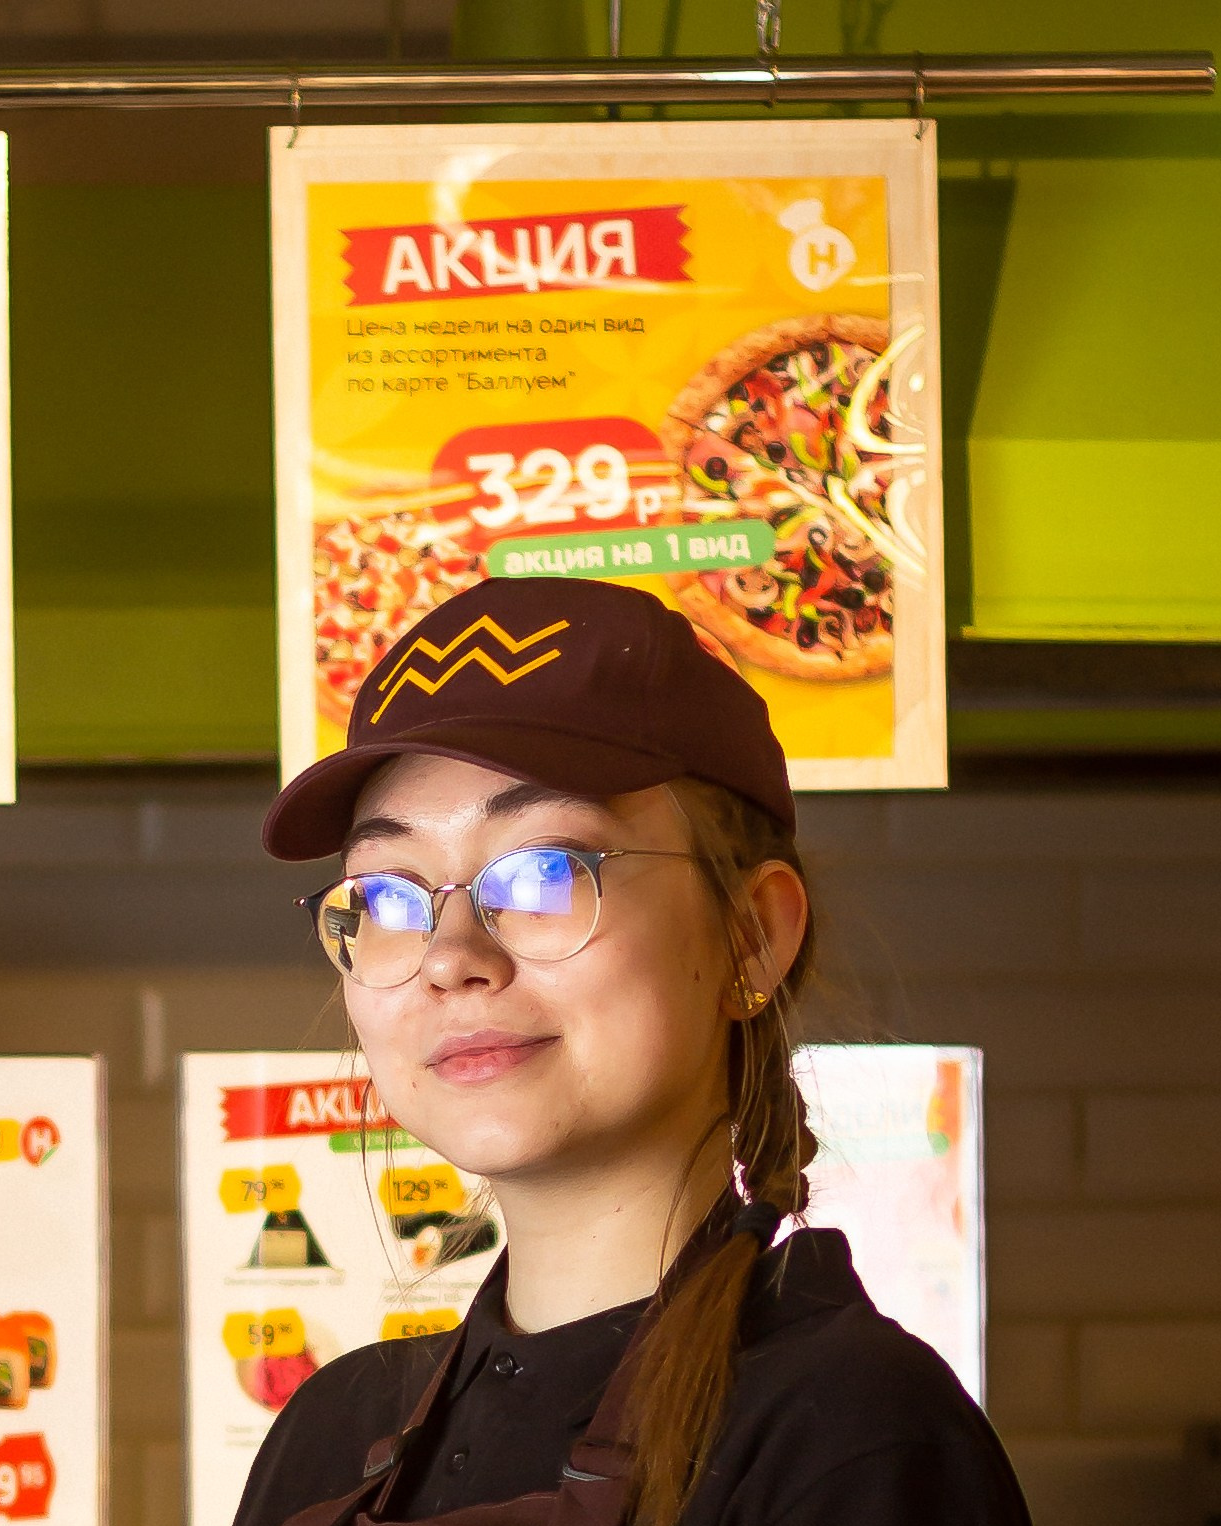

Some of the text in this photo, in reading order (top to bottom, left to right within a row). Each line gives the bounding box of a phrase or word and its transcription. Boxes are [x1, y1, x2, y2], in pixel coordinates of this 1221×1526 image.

[382, 218, 637, 294] АКЦИЯ
[347, 316, 645, 337] Цена недели на один вид
[347, 345, 548, 368] из ассортимента
[347, 375, 375, 392] по
[382, 375, 449, 397] карте
[466, 443, 662, 529] 329 р
[504, 533, 752, 575] акция на 1 вид
[241, 1179, 267, 1202] 79
[393, 1179, 431, 1202] 129
[248, 1323, 275, 1346] 59
